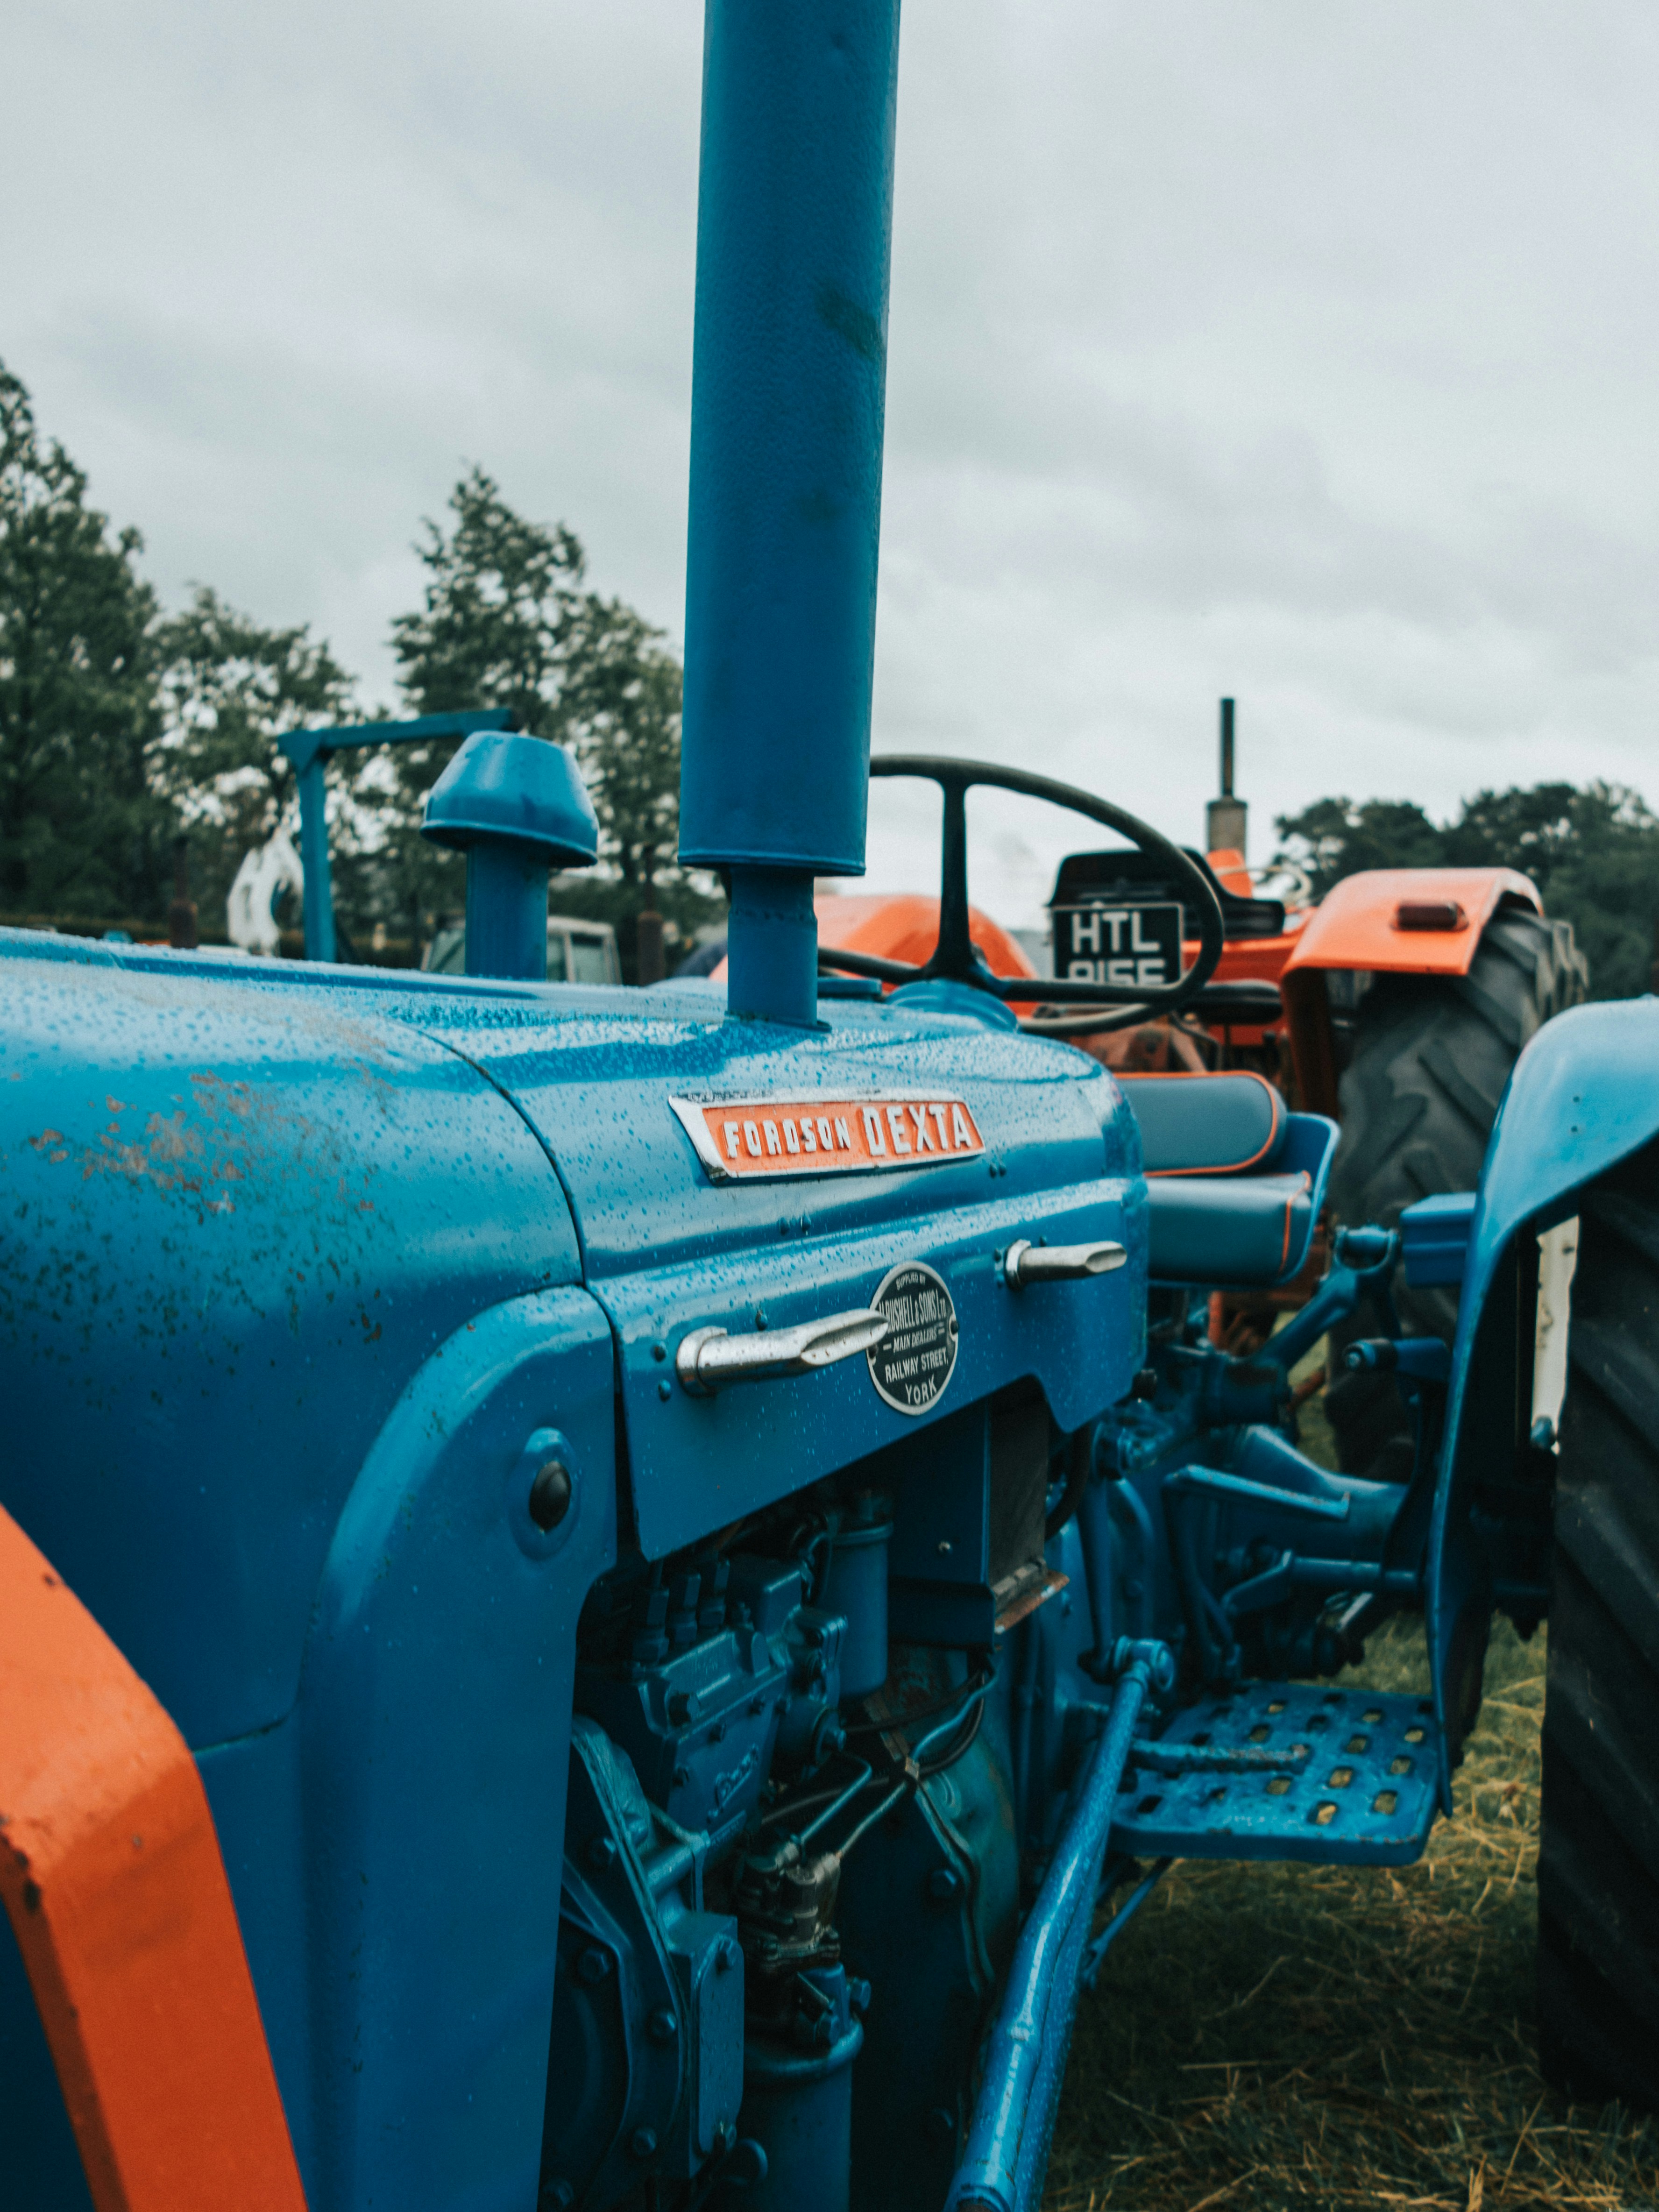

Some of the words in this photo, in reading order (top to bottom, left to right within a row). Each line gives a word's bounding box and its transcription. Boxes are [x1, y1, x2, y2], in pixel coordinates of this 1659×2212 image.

[1072, 912, 1160, 954] HTL
[723, 1116, 851, 1158] FORDSON
[862, 1103, 973, 1156] DEXTA
[896, 1272, 919, 1290] SUPPLIED
[919, 1272, 926, 1285] BY
[915, 1299, 920, 1326] &
[919, 1289, 936, 1325] SONS
[893, 1333, 911, 1354] MAIN
[912, 1326, 937, 1348] DEALERS
[885, 1355, 919, 1384] RAILWAY
[905, 1374, 937, 1405] YORK
